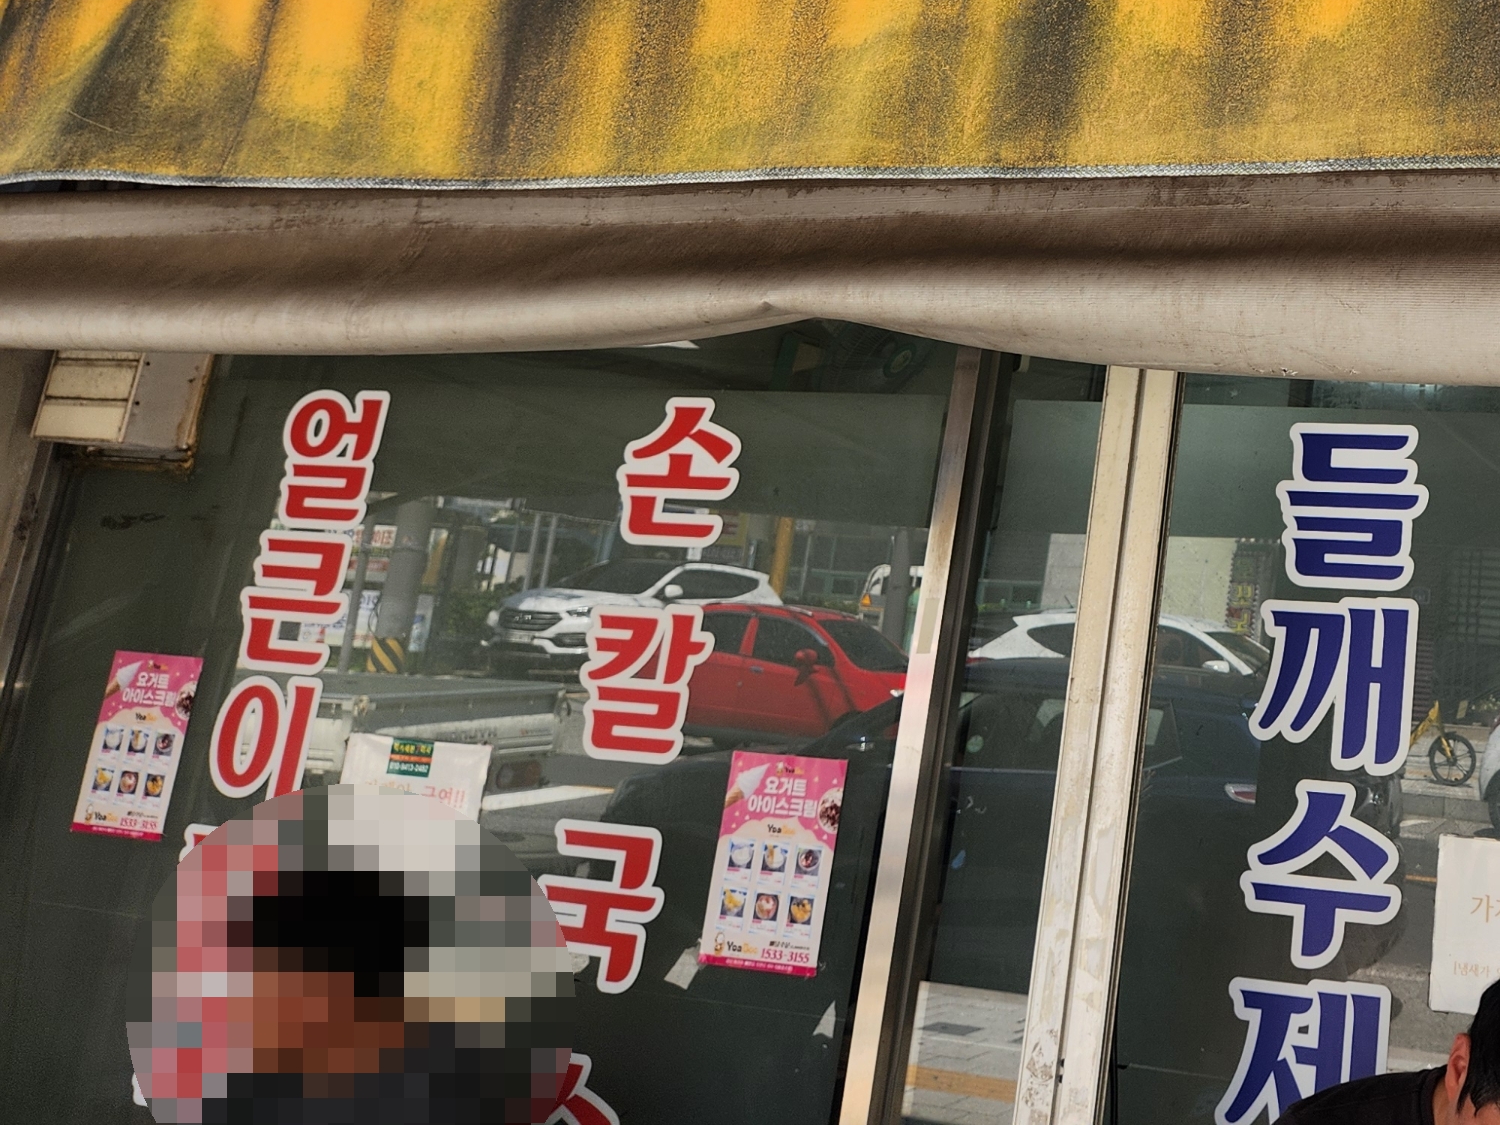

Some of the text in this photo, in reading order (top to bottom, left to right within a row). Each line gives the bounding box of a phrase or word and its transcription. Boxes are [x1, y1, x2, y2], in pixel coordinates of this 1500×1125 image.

[135, 672, 170, 690] 요거트
[540, 396, 742, 1125] 손칼국
[762, 776, 807, 798] 요거트
[748, 795, 820, 819] 아이스크림
[760, 948, 811, 964] 1533-3155
